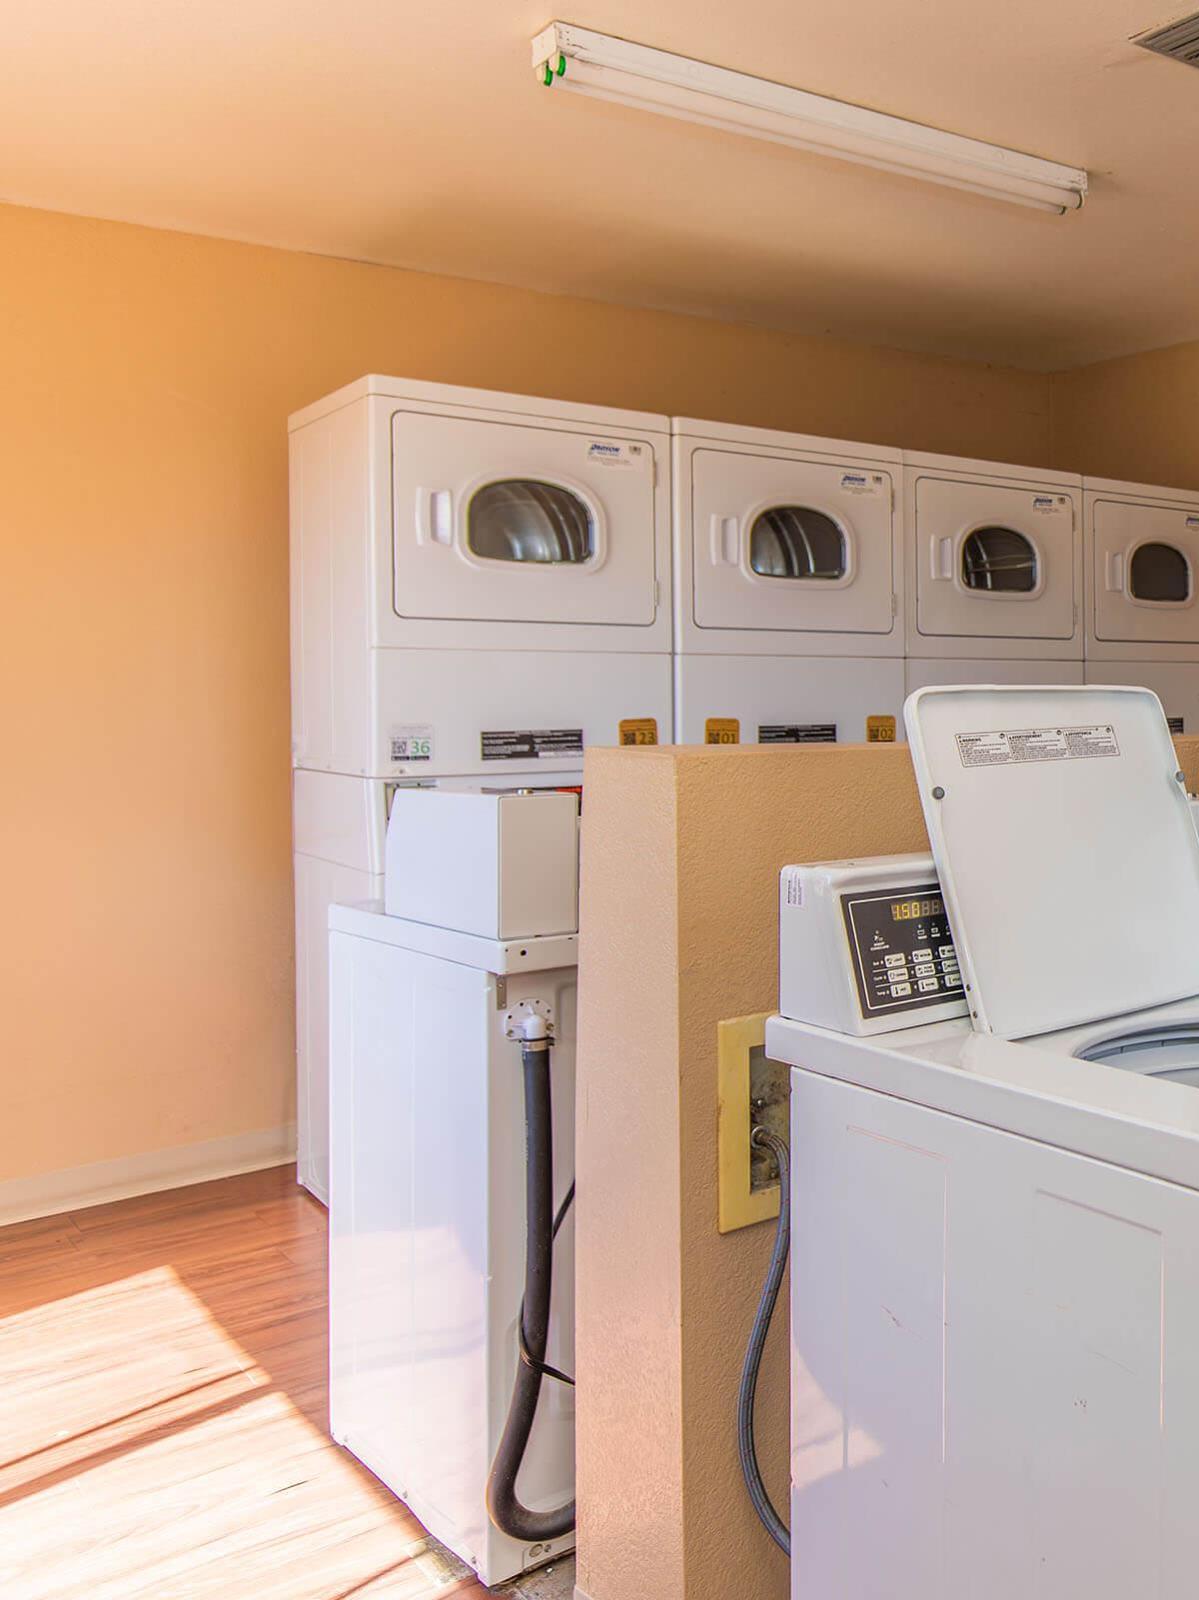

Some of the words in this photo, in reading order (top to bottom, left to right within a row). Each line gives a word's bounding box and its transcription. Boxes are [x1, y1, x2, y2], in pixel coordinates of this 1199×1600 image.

[640, 732, 655, 744] 23
[721, 733, 737, 744] 01
[880, 728, 894, 739] 02
[411, 740, 431, 754] 36
